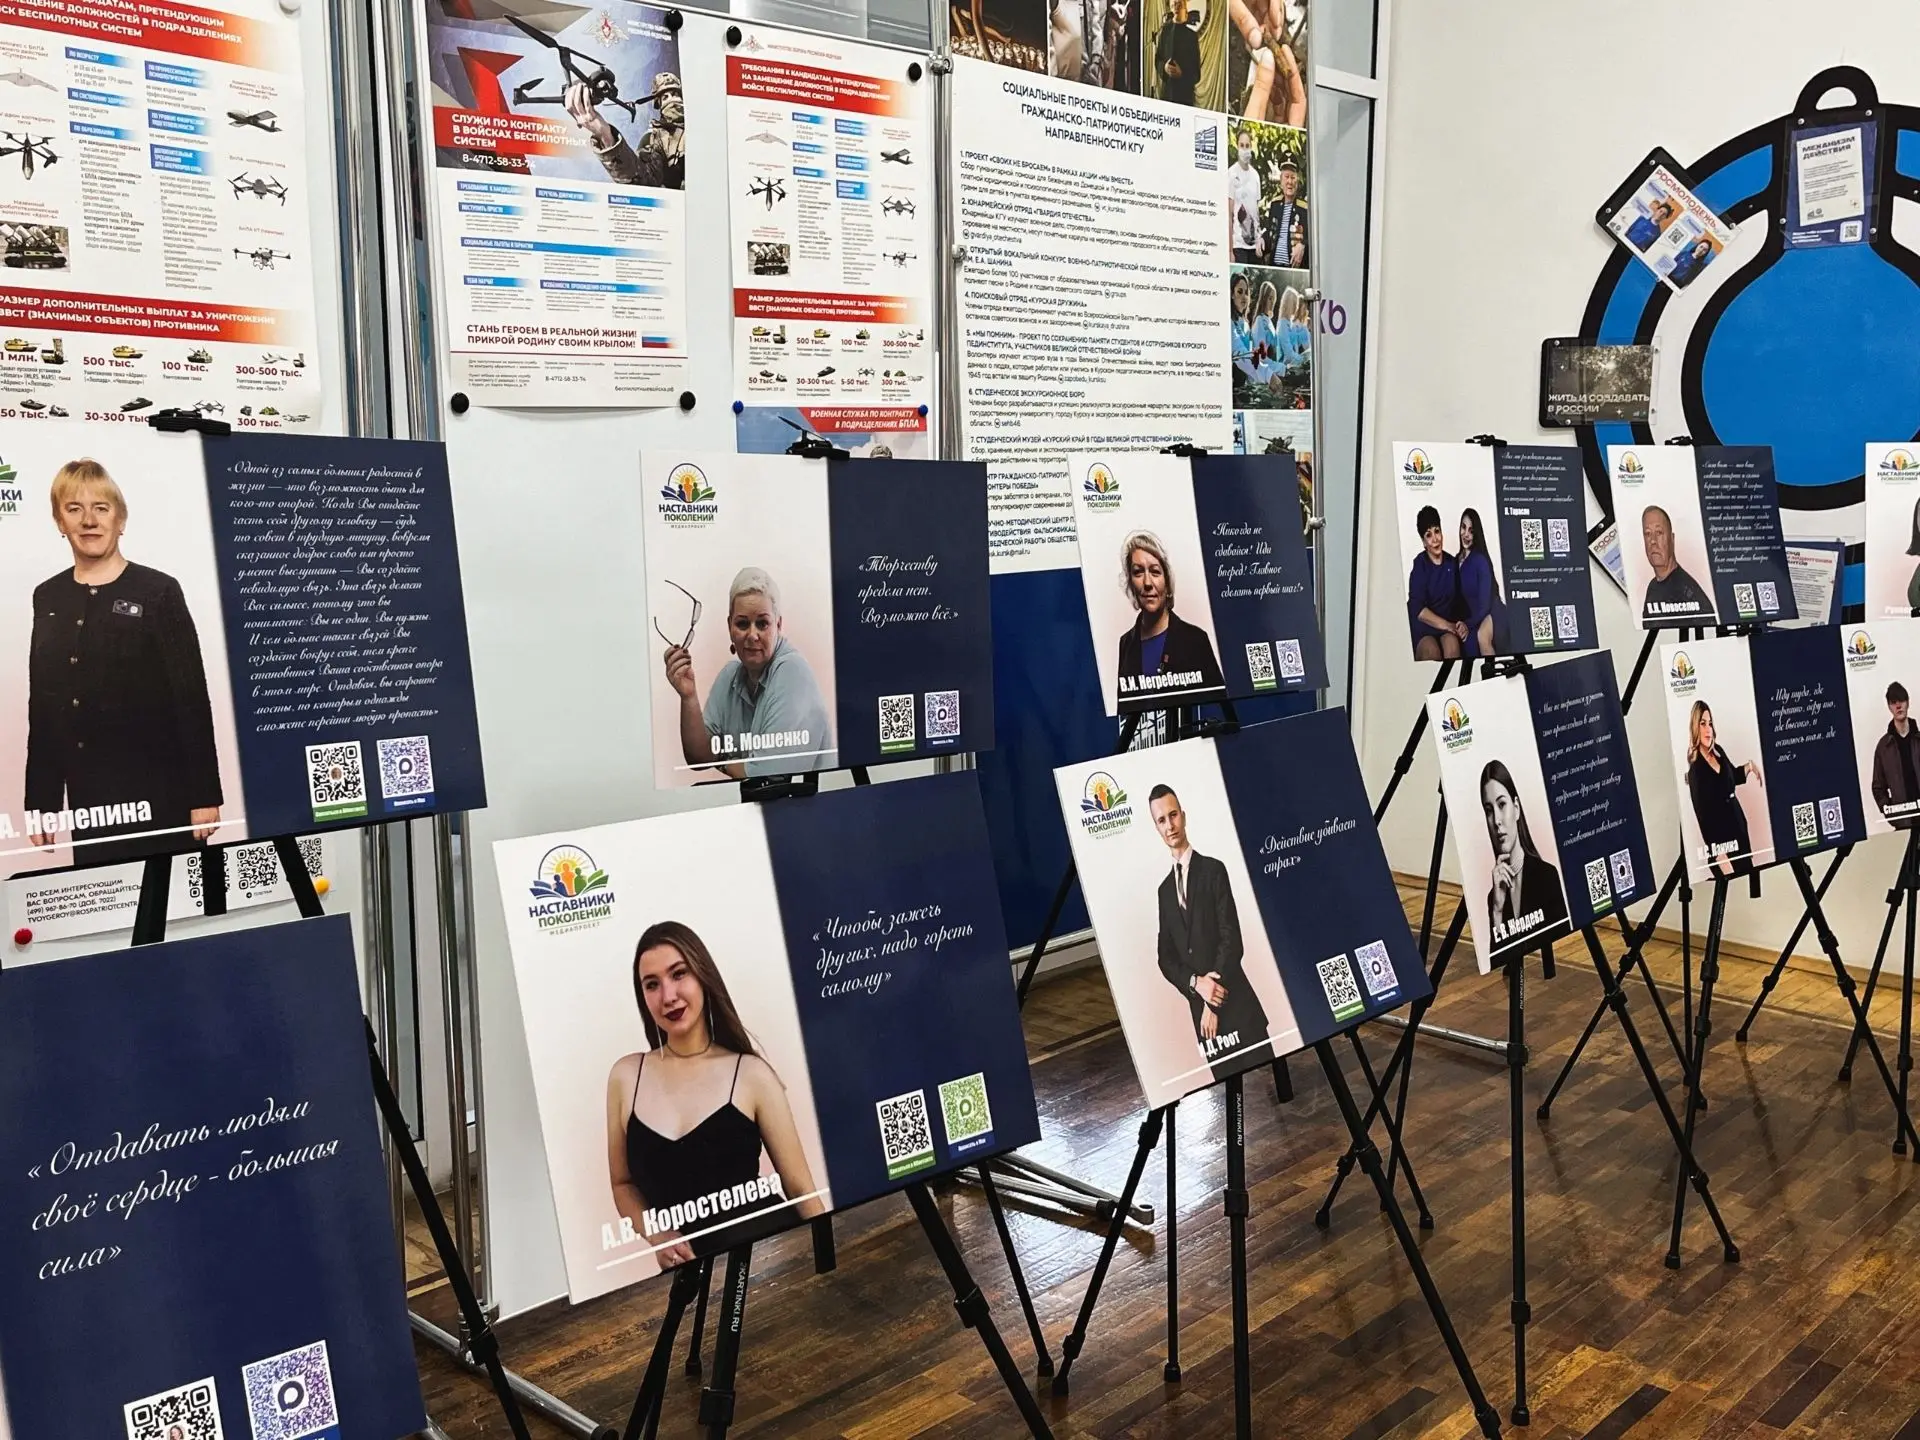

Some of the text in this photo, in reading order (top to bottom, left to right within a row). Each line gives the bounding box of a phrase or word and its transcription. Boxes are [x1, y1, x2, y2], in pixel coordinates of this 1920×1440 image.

[18, 9, 142, 37] БЕСПИЛОТНЫХ СИСТЕМ
[67, 4, 243, 44] ДОЛЖНОСТЕЙ В ПОДРАЗДЕЛЕНИЯХ
[139, 4, 224, 28] ПРЕТЕНДУЮЩИМ
[1003, 81, 1181, 127] СОЦИАЛЬНЫЕ ПРОЕКТЫ И ОБЪЕДИНЕНИЯ
[452, 114, 567, 134] СЛУЖИ ПО КОНТРАКТУ
[1021, 103, 1164, 141] ГРАЖДАНСКО-ПАТРИОТИЧЕСКОЙ
[453, 125, 586, 146] В ВОЙСКАХ БЕСПИЛОТНЫХ
[454, 136, 496, 148] СИСТЕМ
[1045, 126, 1144, 153] НАПРАВЛЕННОСТИ КГУ
[1802, 136, 1855, 152] МЕХАНИЗМ
[463, 153, 536, 168] 8-4712-58-33-74
[965, 151, 988, 161] ПРОЕКТ
[1803, 144, 1851, 160] ДЕЙСТВИЯ
[968, 198, 1033, 215] ЮНАРМЕЙСКИЙ ОТРЯД
[970, 246, 1002, 256] ОТКРЫТЫЙ
[1004, 249, 1040, 260] ВОКАЛЬНЫЙ
[1041, 254, 1066, 264] КОНКУРС
[28, 309, 92, 323] (ЗНАЧИМЫХ
[94, 315, 151, 329] ОБЪЕКТОВ)
[154, 319, 220, 333] ПРОТИВНИКА
[43, 299, 144, 315] ДОПОЛНИТЕЛЬНЫХ
[147, 306, 188, 318] ВЫПЛАТ
[191, 309, 203, 319] ЗА
[205, 311, 276, 325] УНИЧТОЖЕНИЕ
[467, 324, 637, 338] СТАНЬ ГЕРОЕМ В РЕАЛЬНОЙ ЖИЗНИ!
[467, 335, 636, 348] ПРИКРОЙ РОДИНУ СВОИМ КРЫЛОМ!
[83, 356, 105, 366] 500
[162, 360, 181, 371] 100
[236, 365, 276, 377] 300-500
[1548, 393, 1650, 403] ЖИТЬ И СОЗДАВАТЬ
[1, 408, 16, 418] 50
[85, 411, 125, 422] 30-300
[810, 409, 913, 419] ВОЕННАЯ СЛУЖБА ПО КОНТРАКТУ
[1555, 404, 1599, 414] РОССИИ
[237, 417, 257, 427] 300
[834, 418, 920, 430] В ПОДРАЗДЕЛЕНИЯХ БПЛА
[659, 503, 718, 515] НАСТАВНИКИ
[664, 512, 714, 522] ПОКОЛЕНИЙ
[1253, 527, 1262, 535] не
[1255, 541, 1272, 555] Иди
[858, 554, 938, 576] «Творчеству
[1249, 562, 1282, 576] Главное
[858, 583, 932, 604] предела нет.
[1221, 584, 1252, 598] сделать
[1253, 582, 1280, 600] первый
[861, 606, 929, 629] Возможно
[1138, 671, 1203, 690] Негребецкая
[298, 702, 310, 712] по
[313, 697, 362, 714] которым
[256, 719, 307, 732] сможете
[308, 716, 351, 733] перейти
[711, 729, 810, 755] О.В. Мошенко
[24, 800, 152, 836] Нелепина
[1081, 806, 1133, 828] НАСТАВНИКИ
[1088, 817, 1131, 835] ПОКОЛЕНИЙ
[1259, 817, 1357, 855] «Действие убивает
[1263, 854, 1301, 878] страх»
[40, 889, 59, 897] ВСЕМ
[61, 879, 123, 893] ИНТЕРЕСУЮЩИМ
[43, 893, 86, 904] ВОПРОСАМ,
[88, 884, 141, 897] ОБРАЩАЙТЕСЬ
[27, 907, 44, 916] (499)
[45, 902, 77, 912] 967-86-70
[99, 896, 117, 904] 7022)
[529, 892, 615, 917] НАСТАВНИКИ
[538, 905, 611, 928] ПОКОЛЕНИЙ
[812, 903, 942, 942] «Чтобы зажечь
[1507, 908, 1545, 937] Жердева
[549, 921, 601, 936] МЕДИАПРОЕКТ
[816, 923, 974, 978] других, надо гореть
[821, 969, 892, 998] самому»
[1216, 1030, 1240, 1051] Роот
[218, 1096, 314, 1137] людям
[31, 1192, 98, 1232] своё
[104, 1169, 201, 1221] сердце
[228, 1138, 343, 1182] большая
[601, 1172, 783, 1250] А.В. Коростелева
[38, 1244, 123, 1281] сила»
